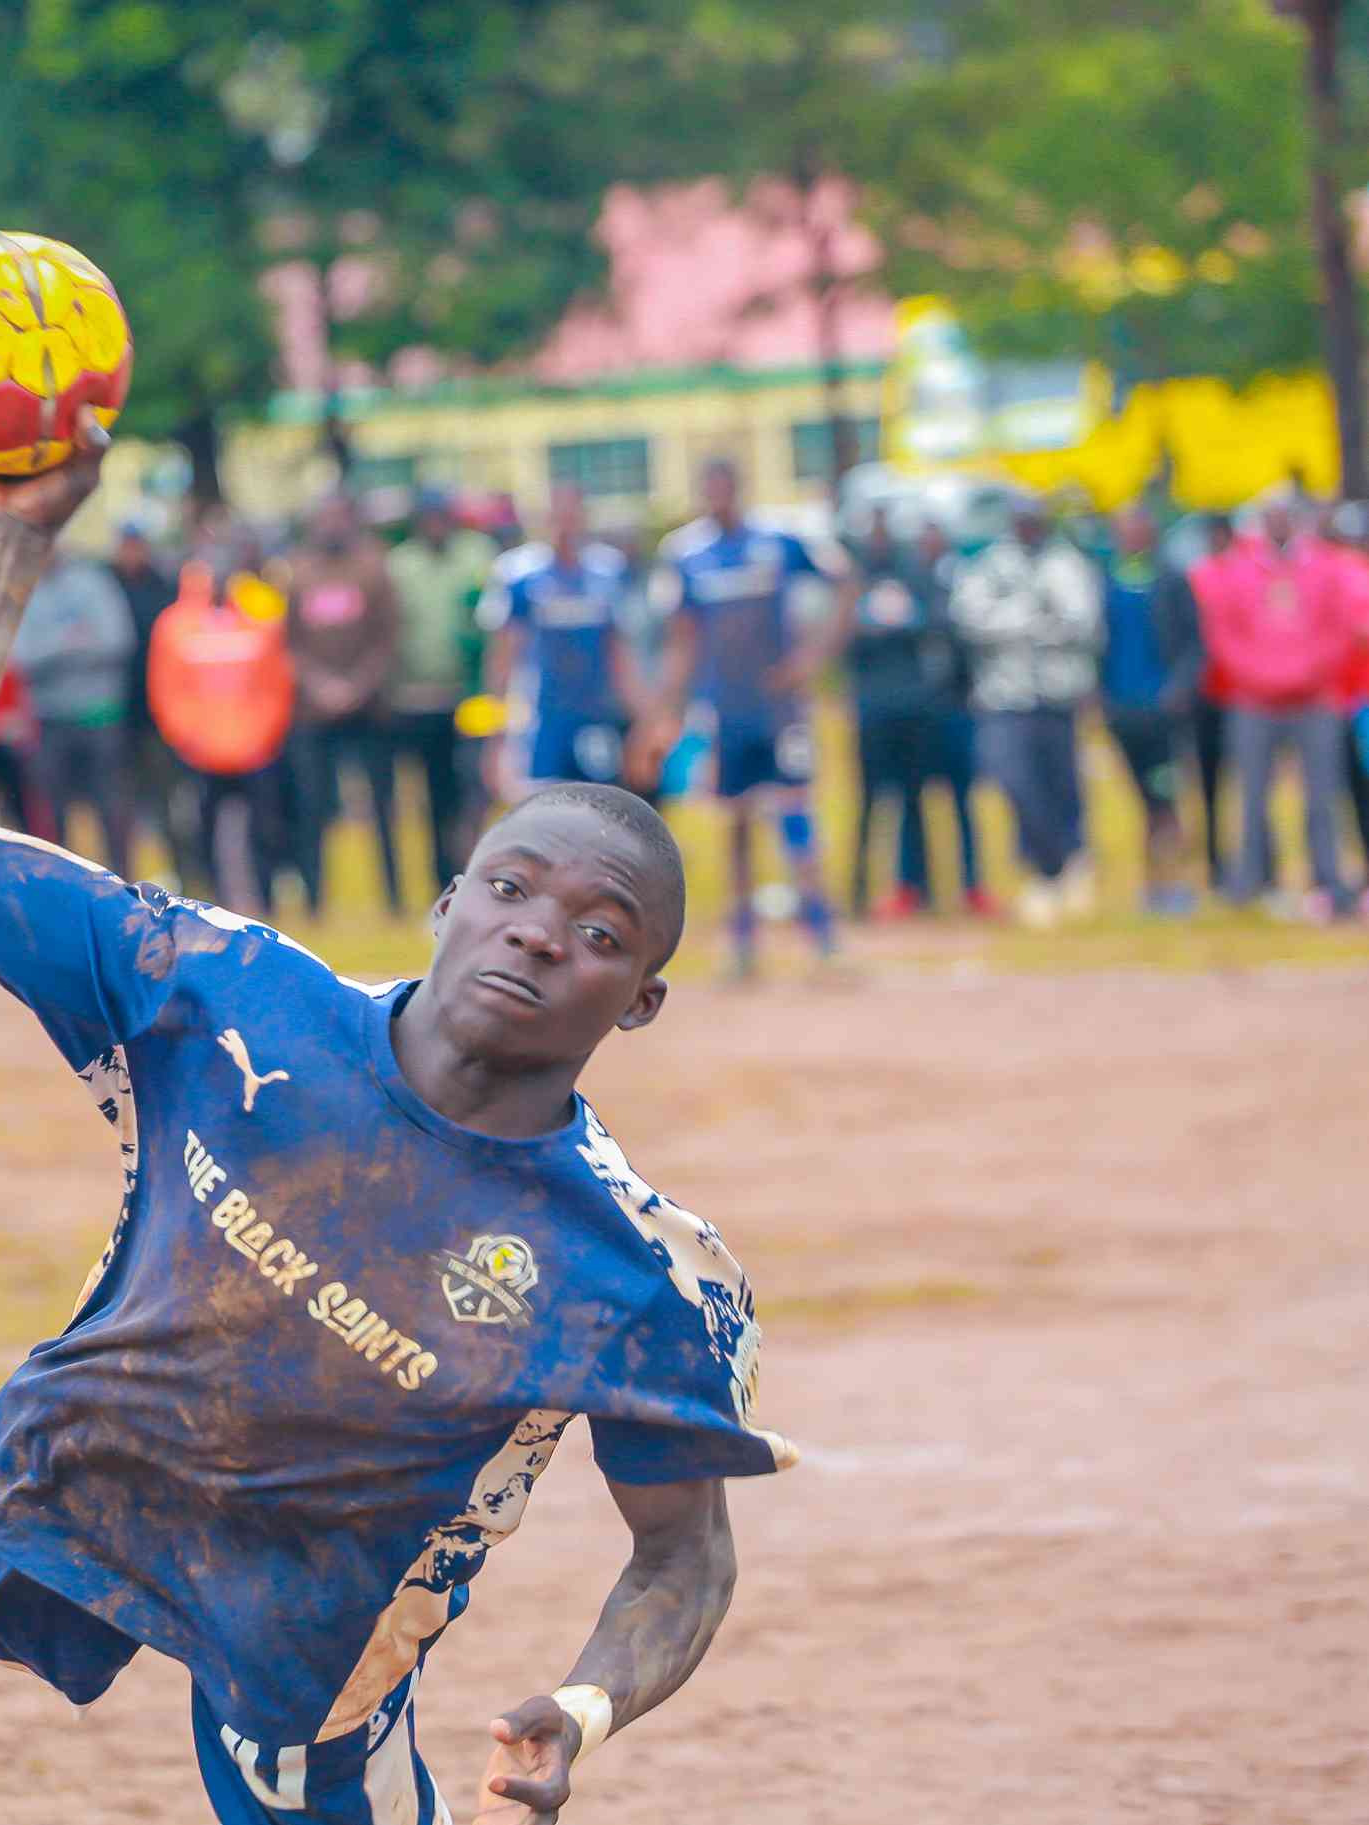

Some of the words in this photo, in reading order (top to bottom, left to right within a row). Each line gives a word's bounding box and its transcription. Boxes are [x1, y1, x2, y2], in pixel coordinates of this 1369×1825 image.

[183, 1129, 228, 1203] THE
[211, 1188, 319, 1297] BLACK
[307, 1281, 439, 1390] SAINTS
